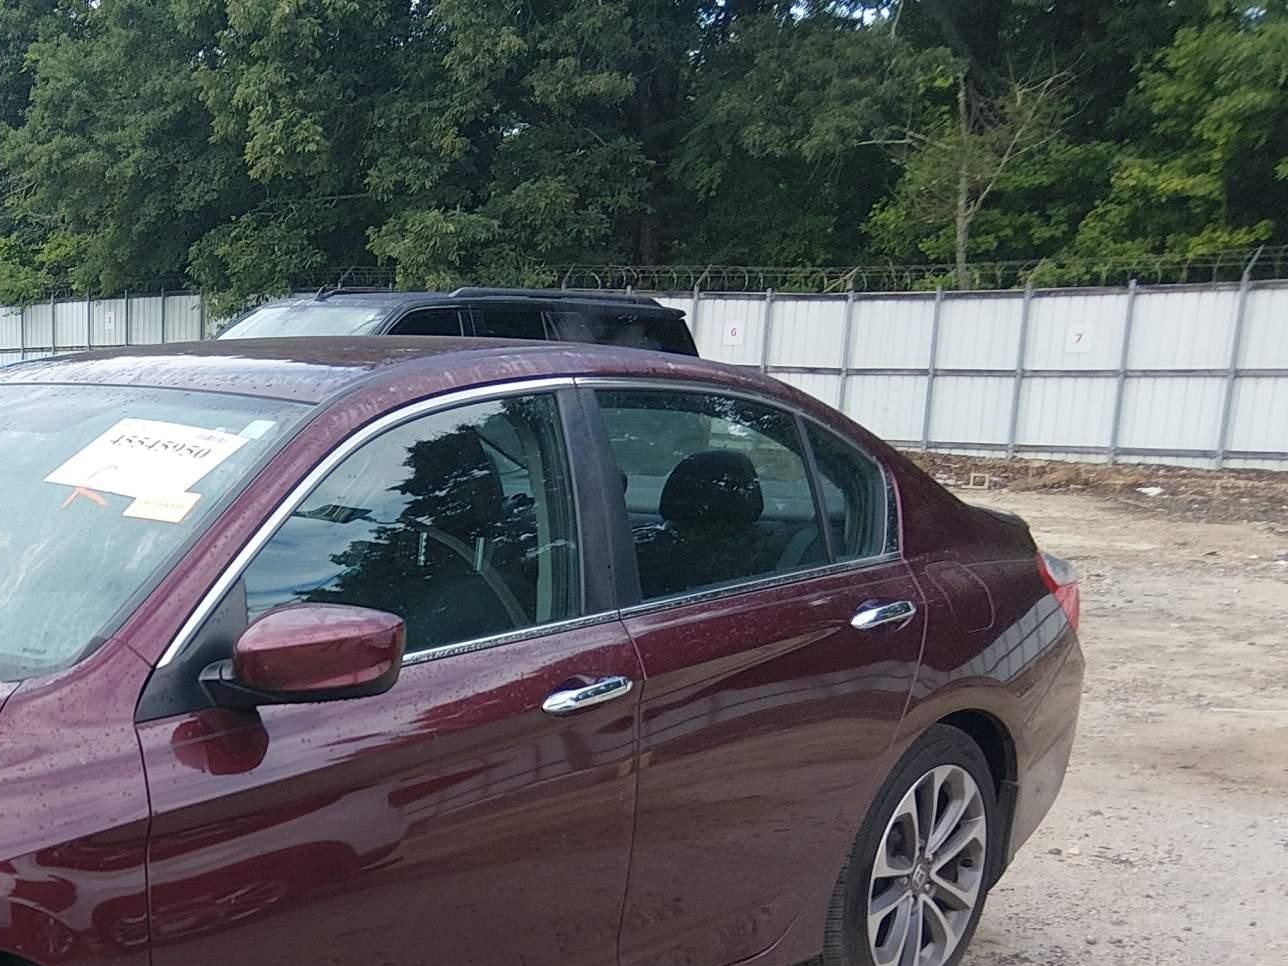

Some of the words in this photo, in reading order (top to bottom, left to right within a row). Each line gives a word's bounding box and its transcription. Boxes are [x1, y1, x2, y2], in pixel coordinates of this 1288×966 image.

[730, 327, 737, 337] 6
[1074, 332, 1083, 345] 7
[110, 434, 212, 459] 45545950
